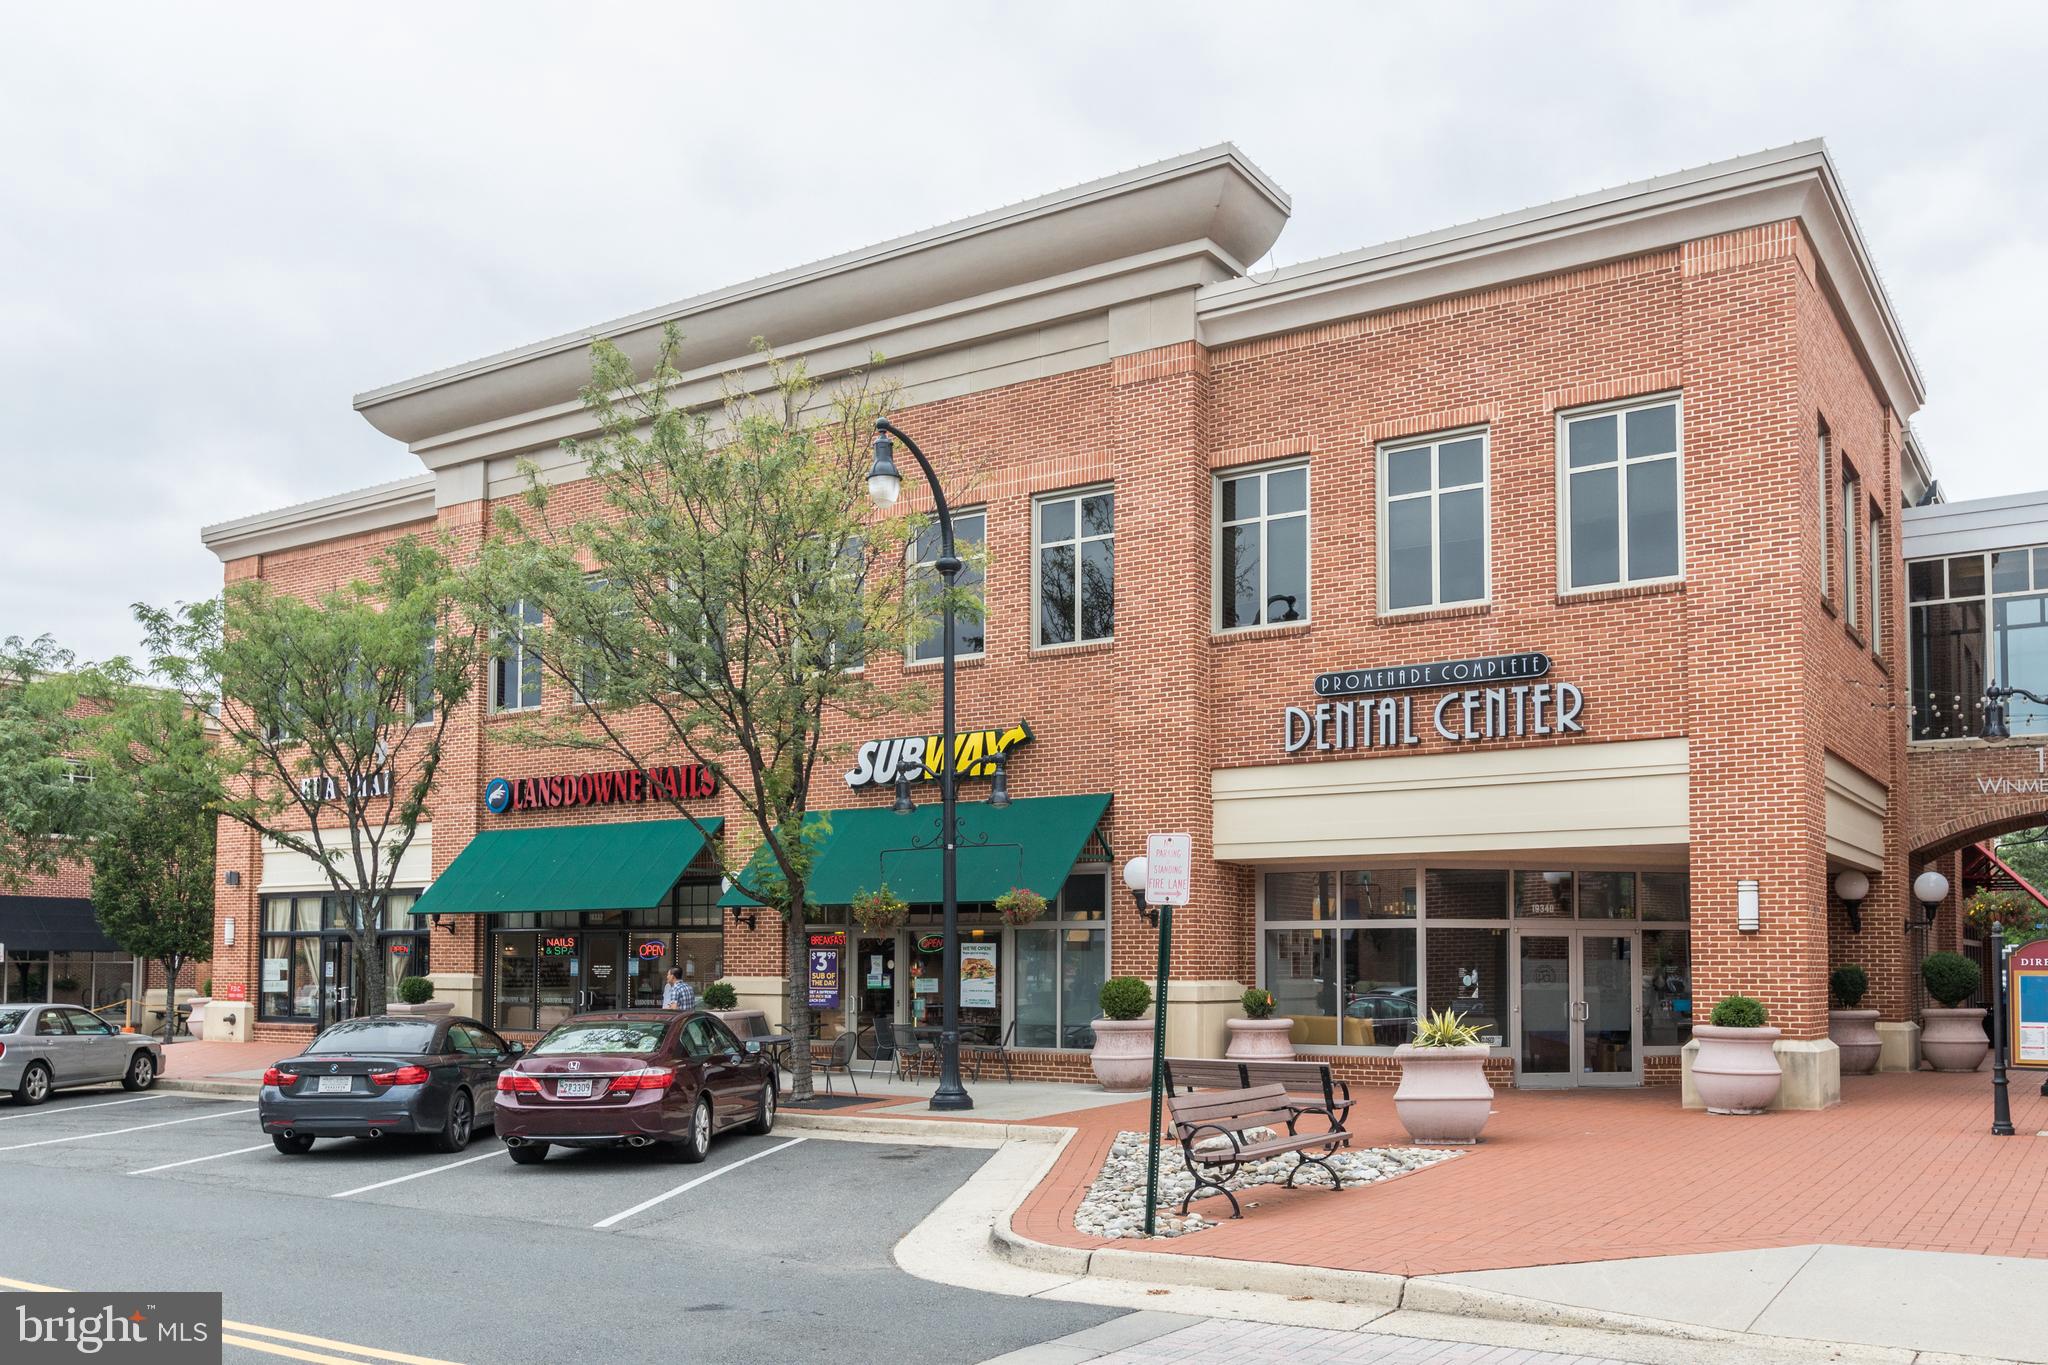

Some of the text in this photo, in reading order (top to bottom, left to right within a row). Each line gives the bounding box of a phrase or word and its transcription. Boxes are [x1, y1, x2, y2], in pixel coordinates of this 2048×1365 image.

[1321, 656, 1541, 692] PROMENADE COMPLETE
[1284, 682, 1583, 752] DENTAL CENTER
[844, 724, 1027, 787] SUBWAY
[512, 764, 717, 810] LANSDOWNE NAILS
[1155, 849, 1183, 858] PARKING
[1154, 865, 1183, 874] STANDING
[1149, 879, 1187, 890] FIRE LANE
[546, 937, 576, 947] NAILS
[810, 935, 847, 945] BREAKFAST
[921, 939, 944, 948] OPEN
[546, 947, 576, 956] & SPA
[639, 944, 665, 957] OPEN
[811, 972, 836, 980] SUB OF
